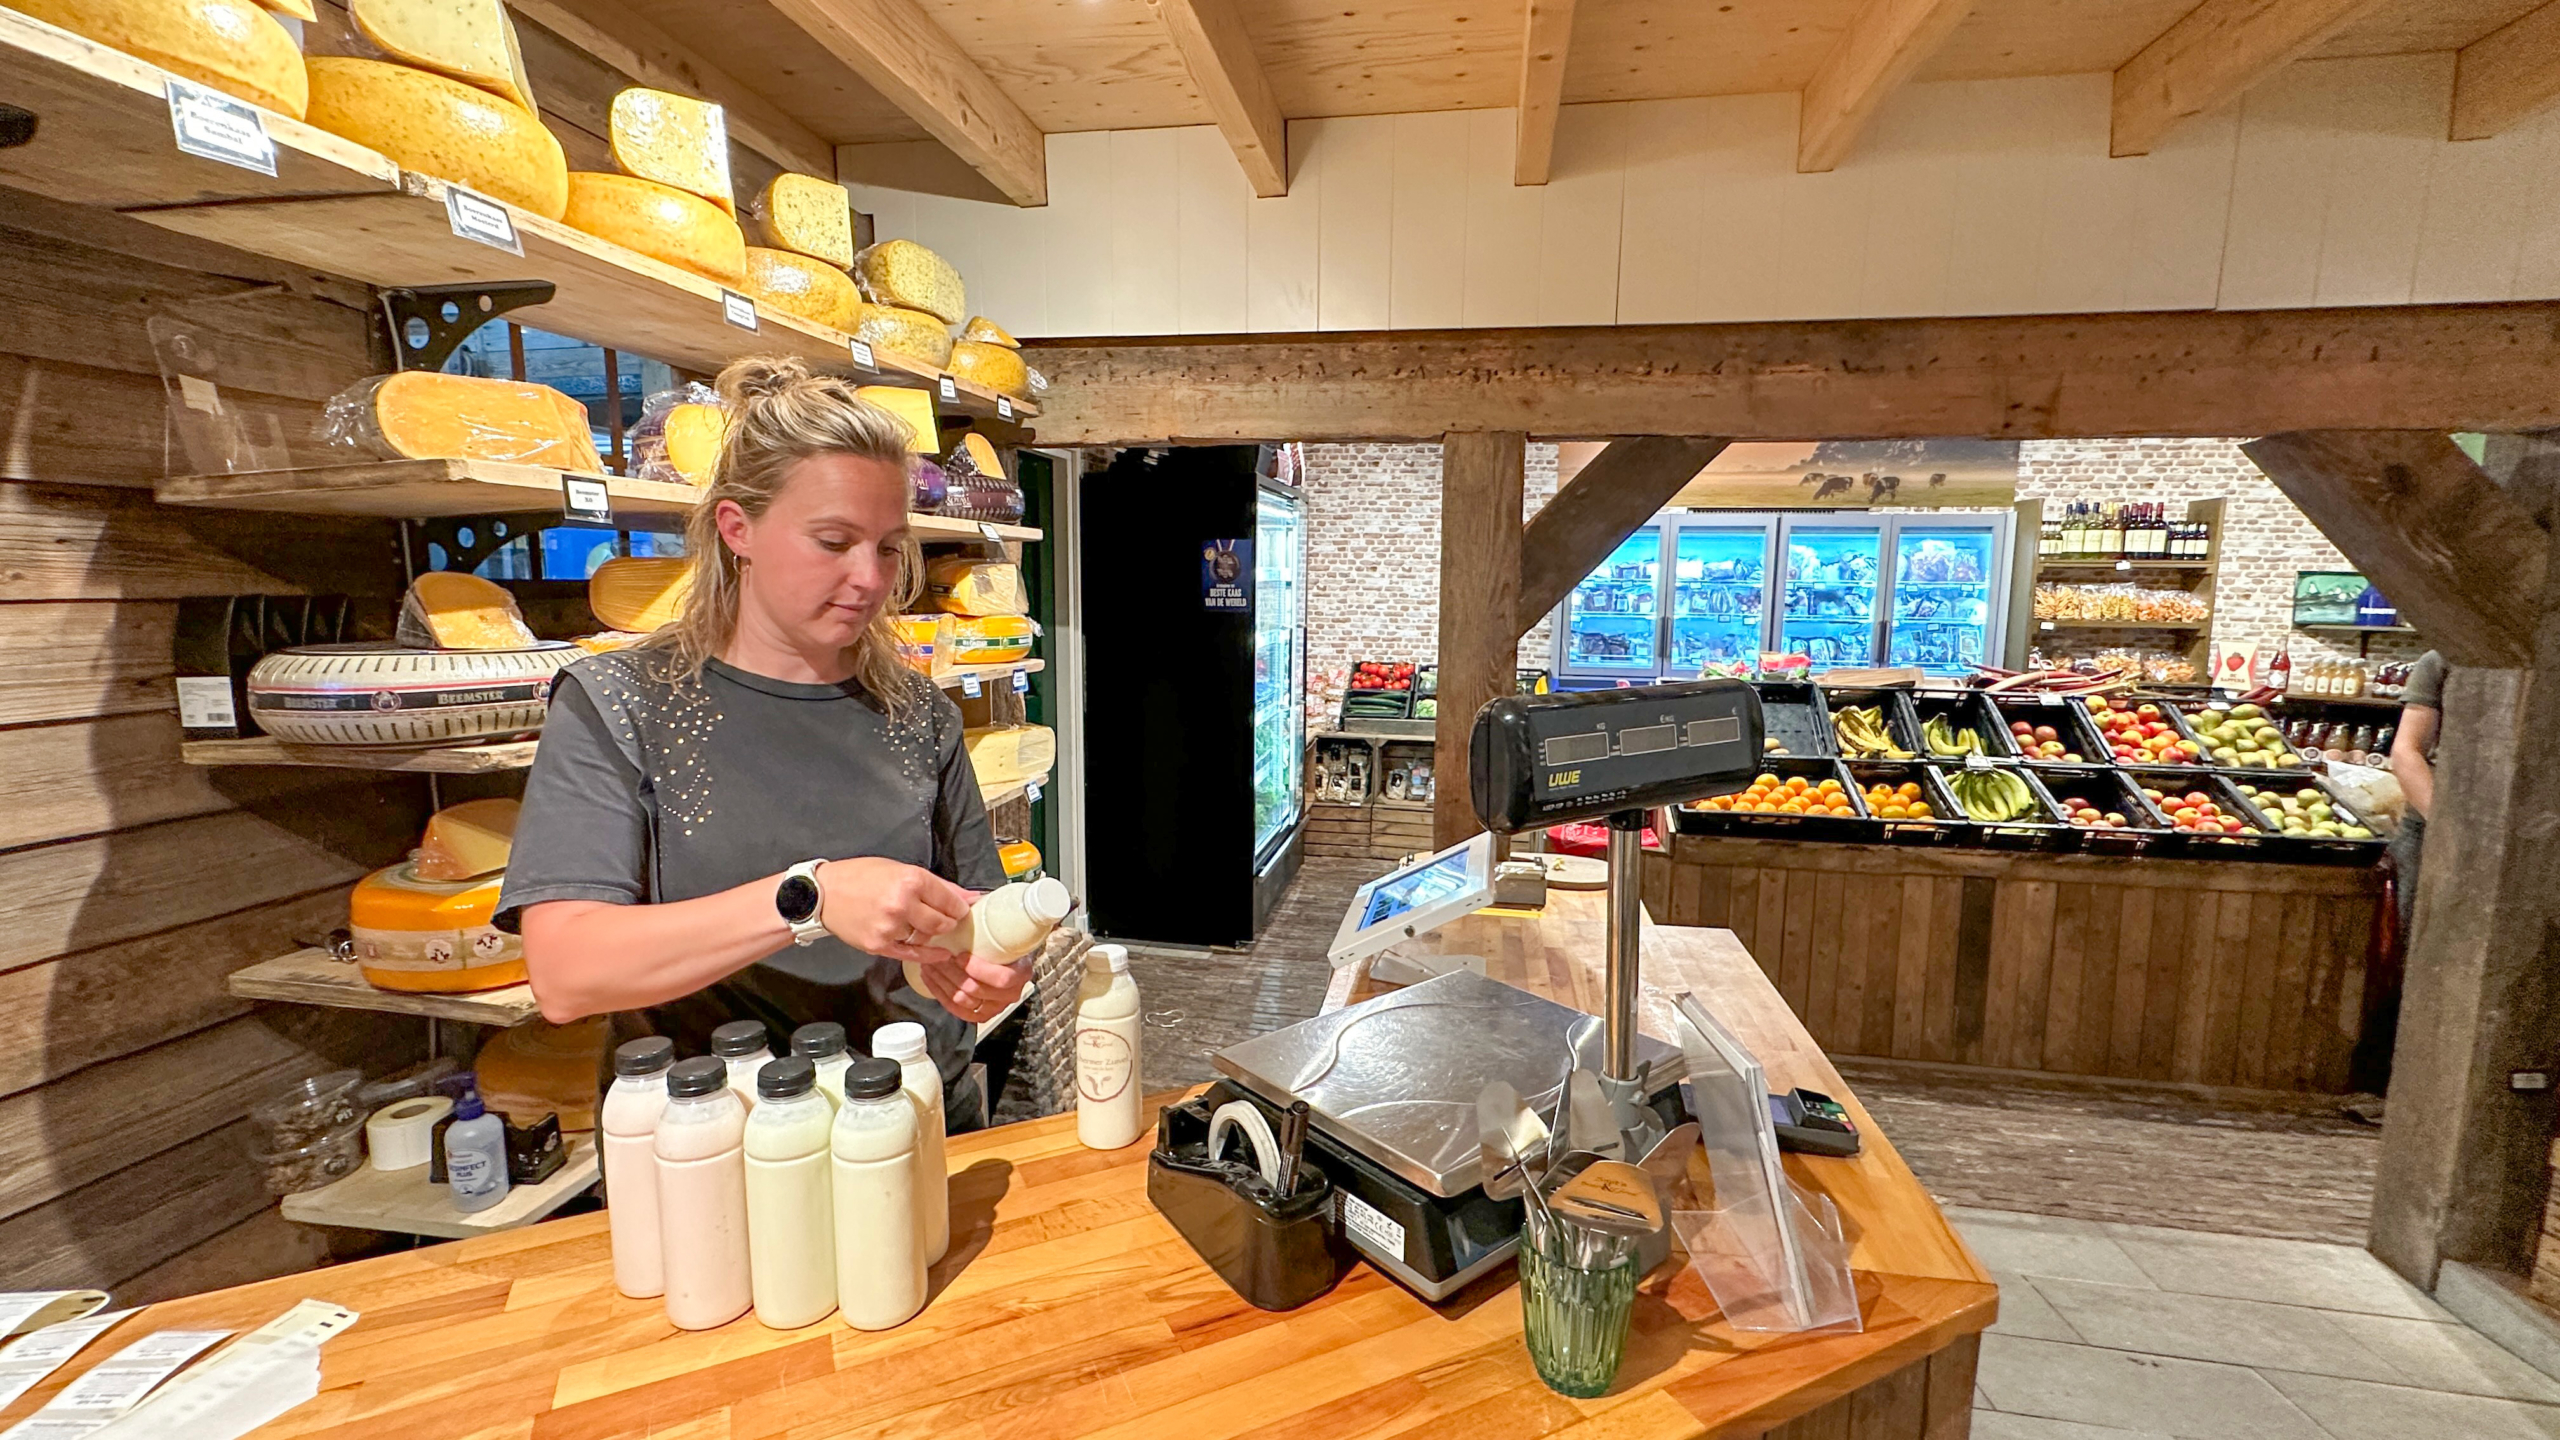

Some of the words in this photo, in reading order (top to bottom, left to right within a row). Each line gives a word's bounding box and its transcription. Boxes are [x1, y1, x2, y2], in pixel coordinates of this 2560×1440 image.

[1209, 588, 1227, 598] BESTE
[1204, 597, 1217, 607] VAN
[1217, 597, 1225, 607] DE
[283, 696, 338, 710] BEEMSTER
[437, 690, 504, 706] BEEMSTER
[1548, 769, 1582, 788] UWE
